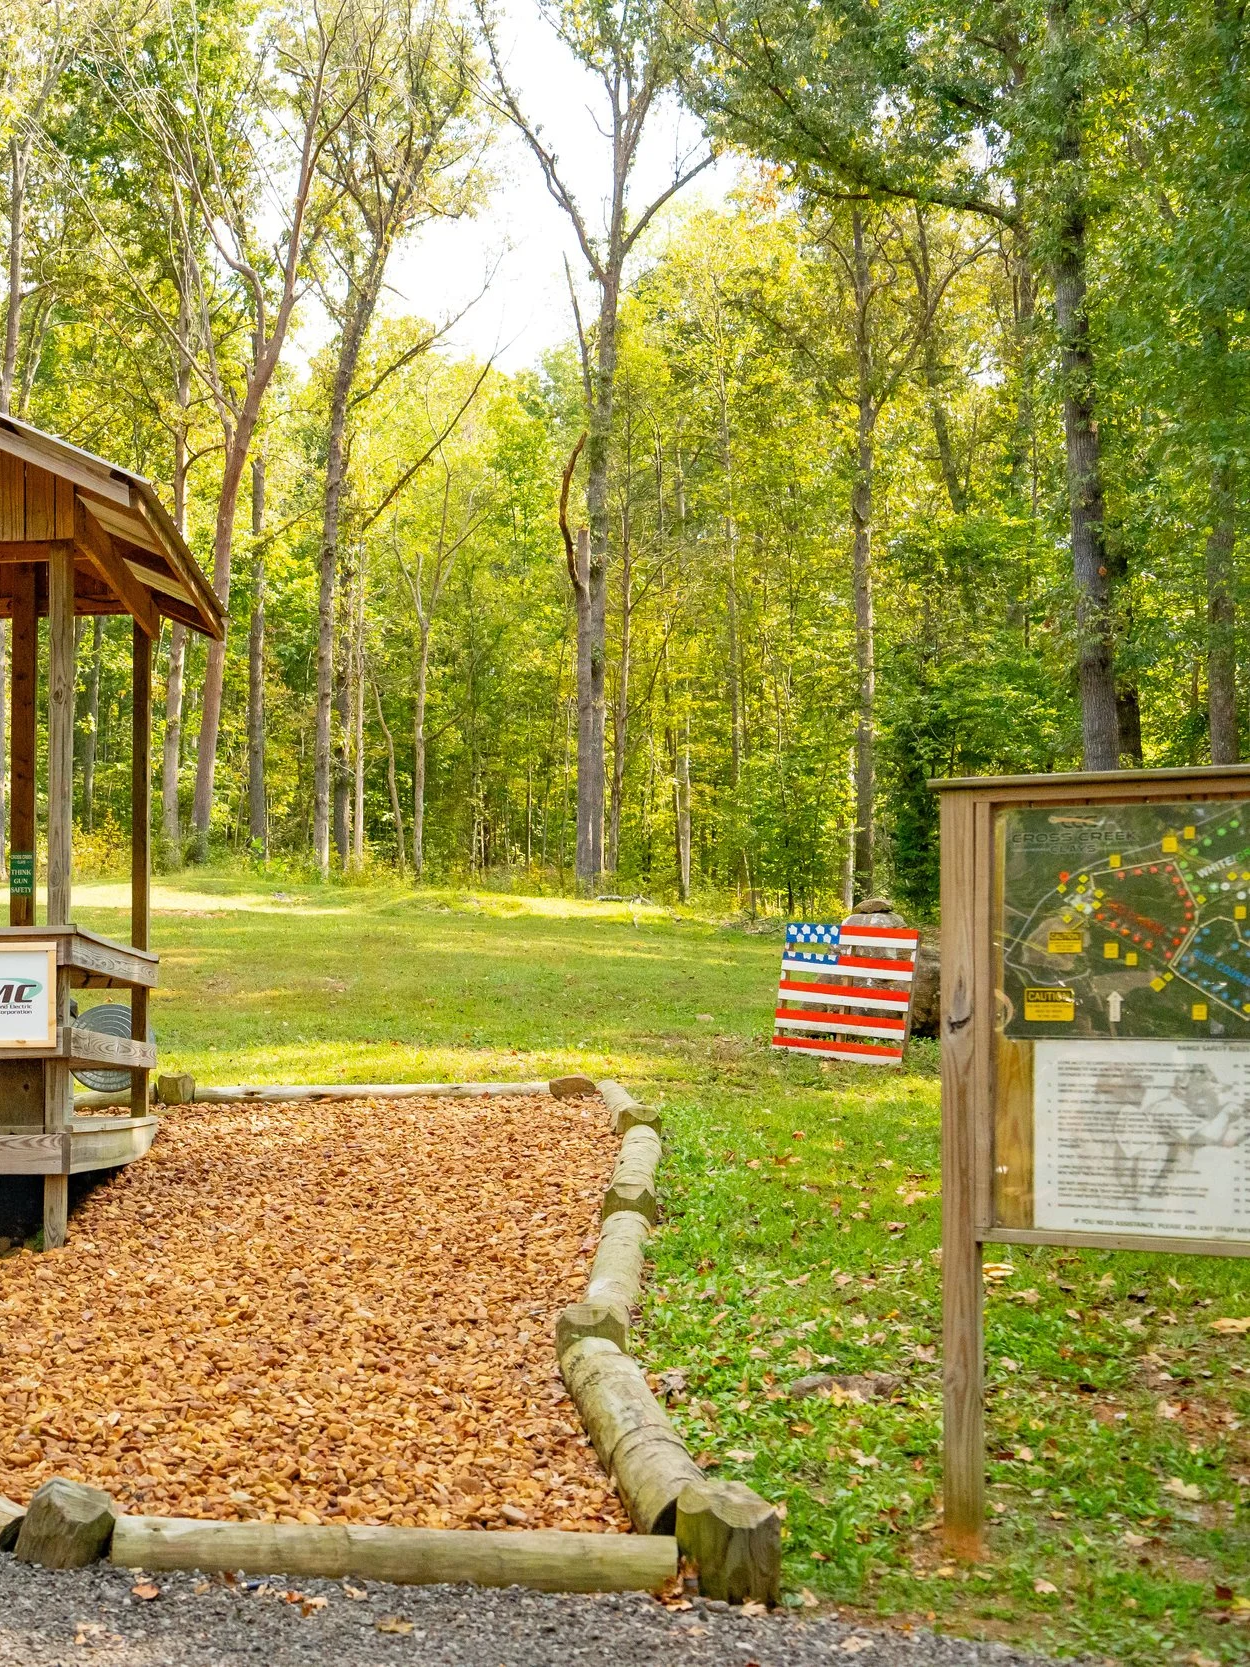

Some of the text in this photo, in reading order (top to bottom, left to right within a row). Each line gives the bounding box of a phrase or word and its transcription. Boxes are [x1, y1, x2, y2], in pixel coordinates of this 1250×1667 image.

[1011, 831, 1136, 843] CROSS CREEK
[1050, 844, 1097, 854] CLAYS
